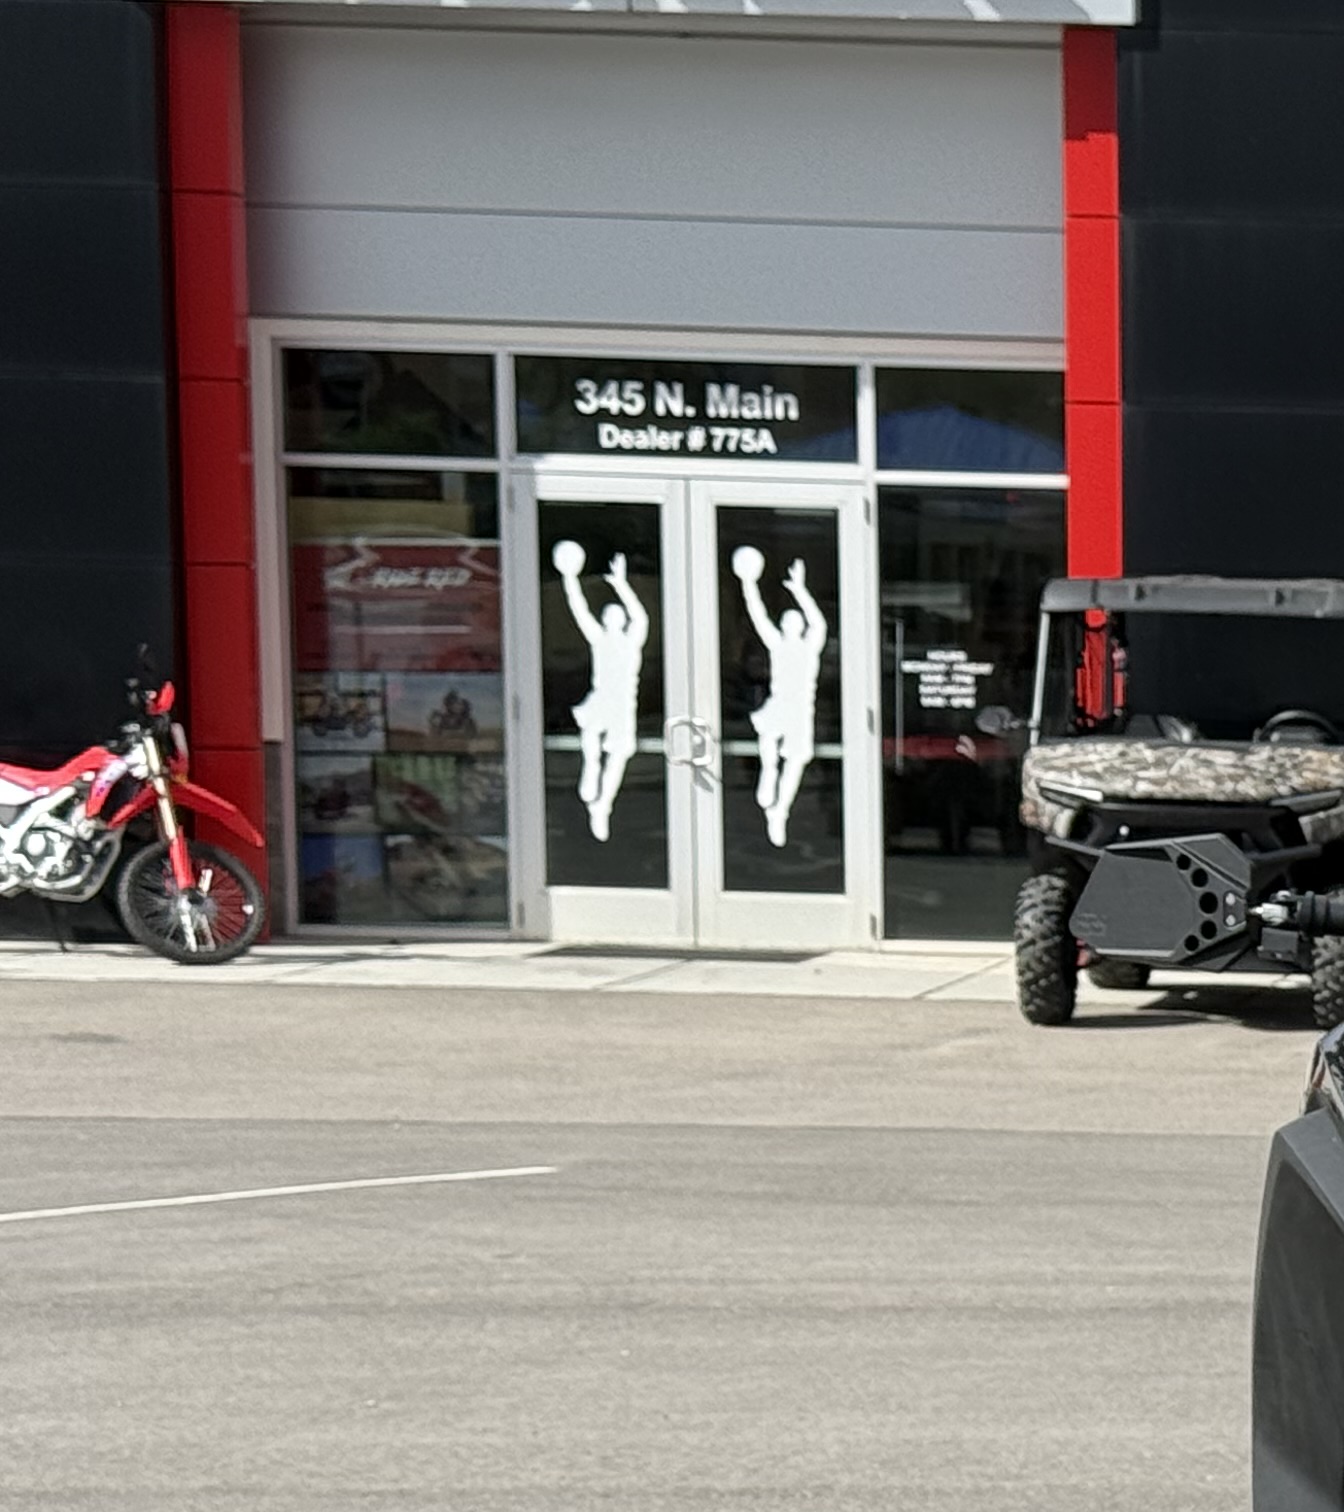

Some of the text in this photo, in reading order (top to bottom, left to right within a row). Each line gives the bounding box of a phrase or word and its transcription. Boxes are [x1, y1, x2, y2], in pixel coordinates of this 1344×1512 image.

[574, 378, 800, 421] 345 N. Main
[598, 422, 779, 454] Dealer # 775A
